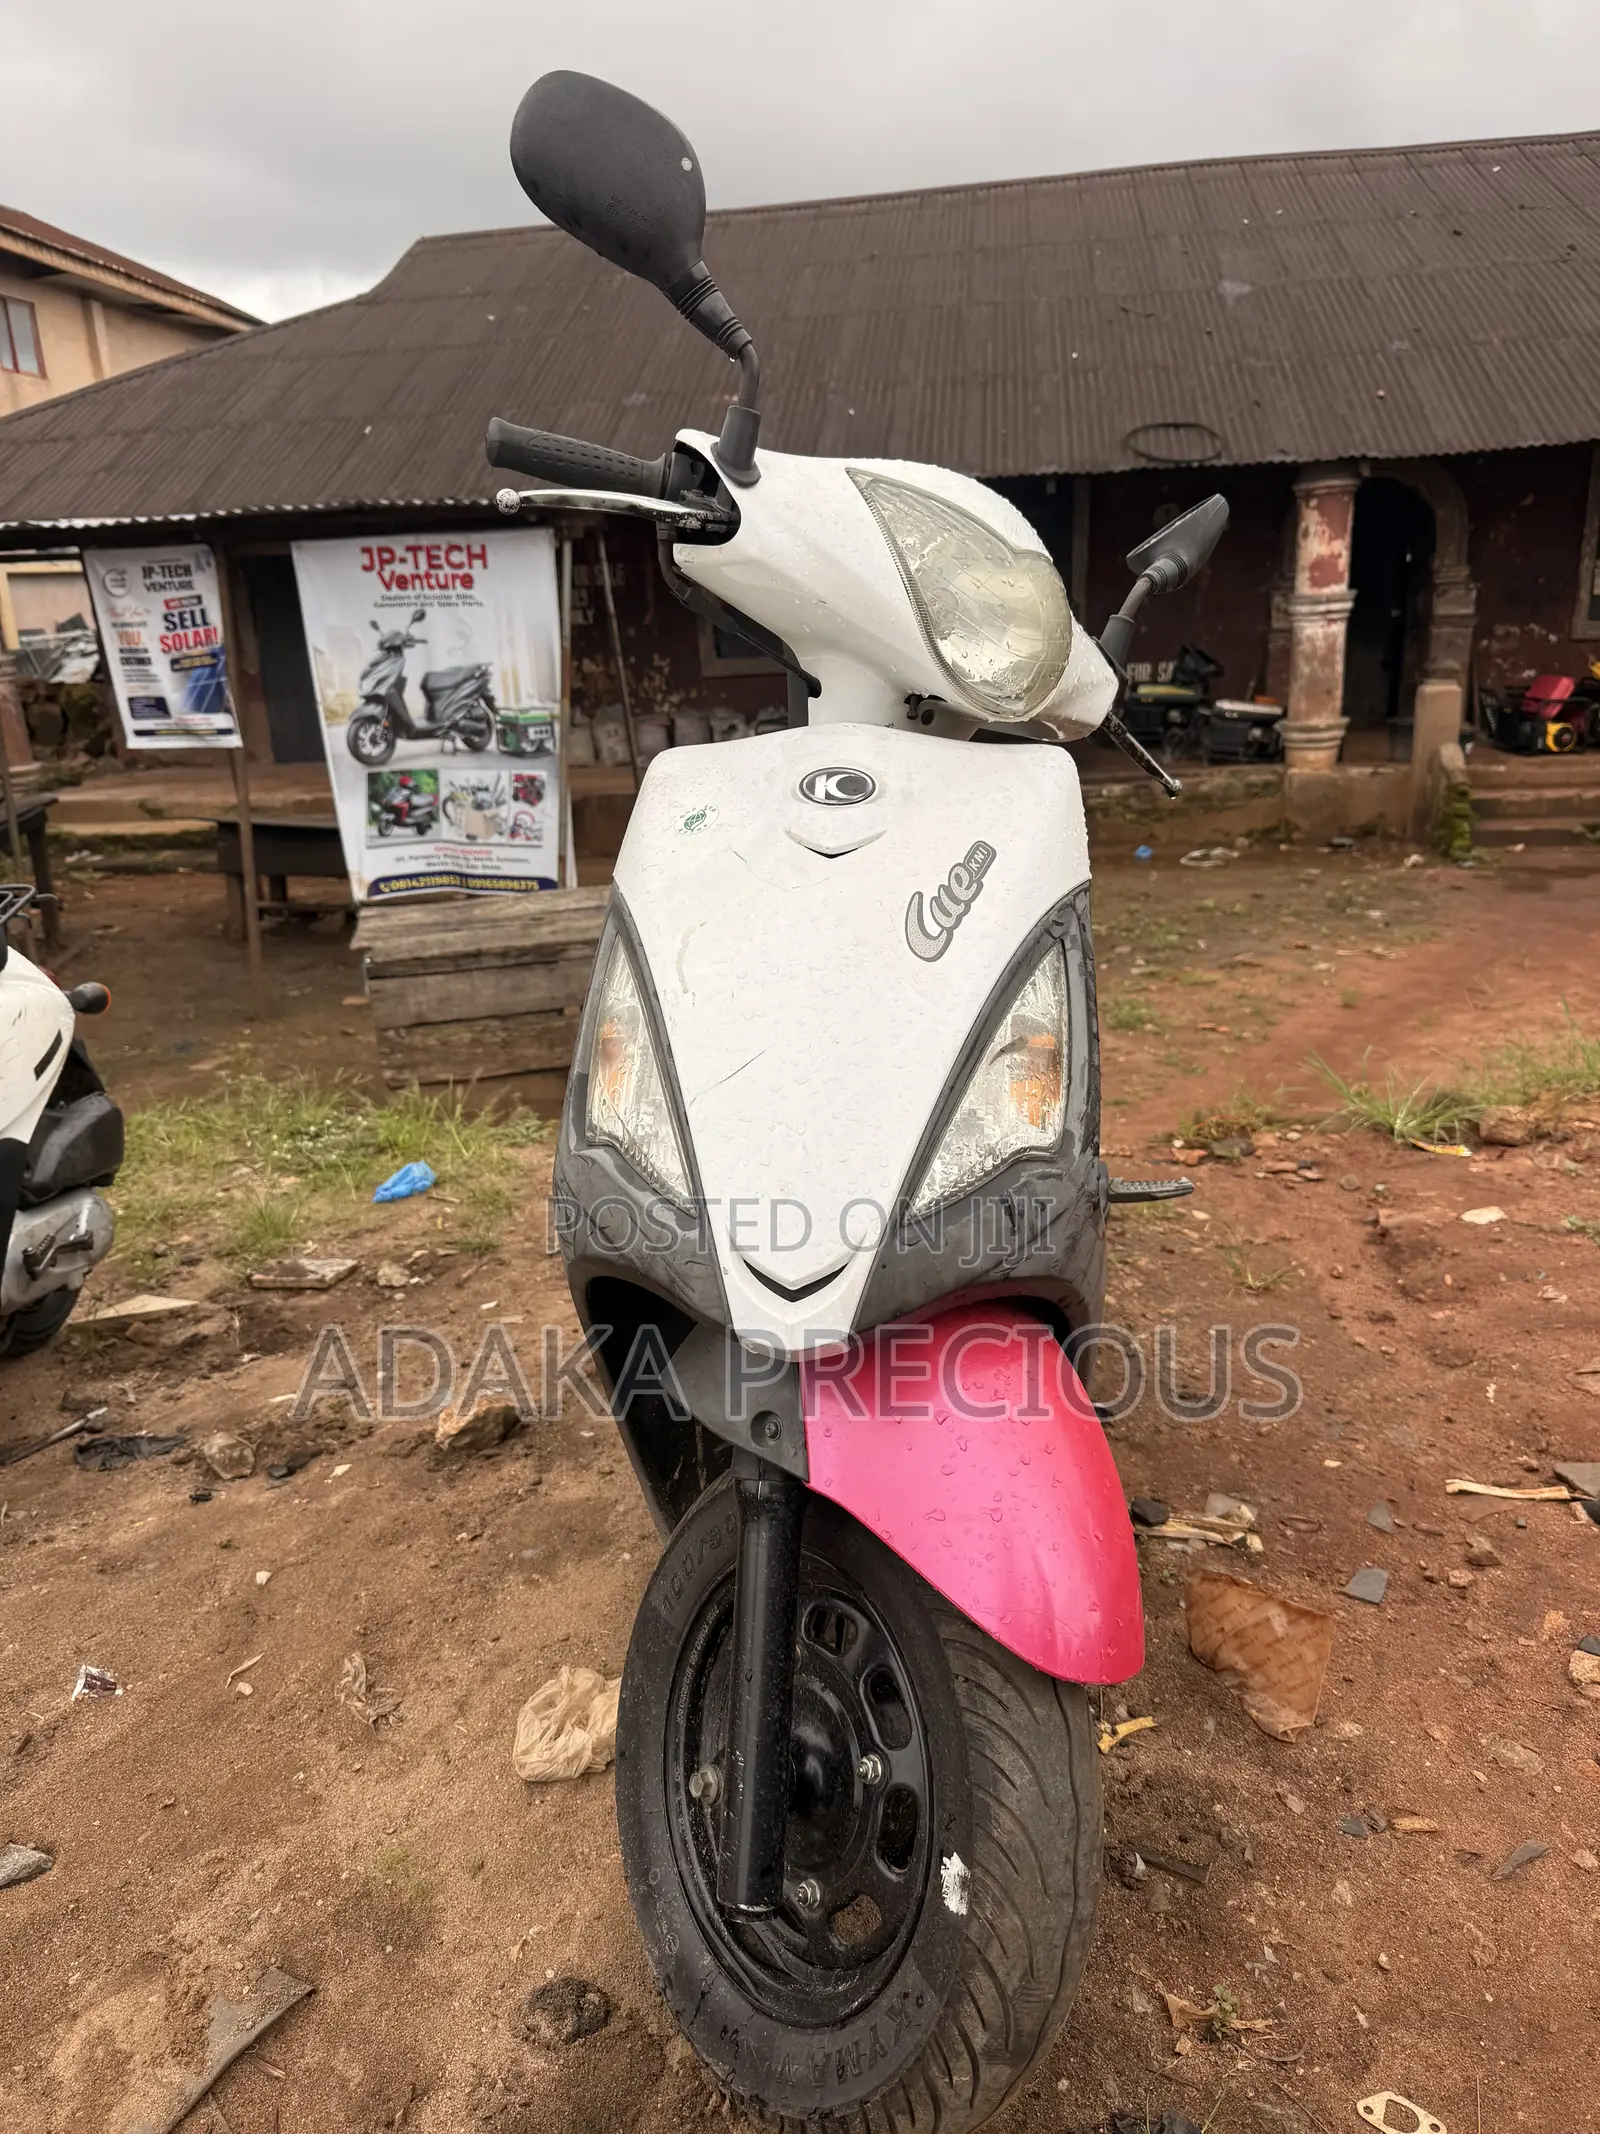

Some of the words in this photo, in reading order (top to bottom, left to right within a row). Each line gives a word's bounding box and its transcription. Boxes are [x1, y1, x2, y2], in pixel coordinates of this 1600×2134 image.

[359, 543, 488, 572] JP-TECH
[141, 563, 193, 579] JP-TECH
[377, 569, 475, 592] Venture
[143, 579, 195, 593] VENTURE
[163, 608, 211, 633] SELL
[159, 626, 220, 654] SOLAR!
